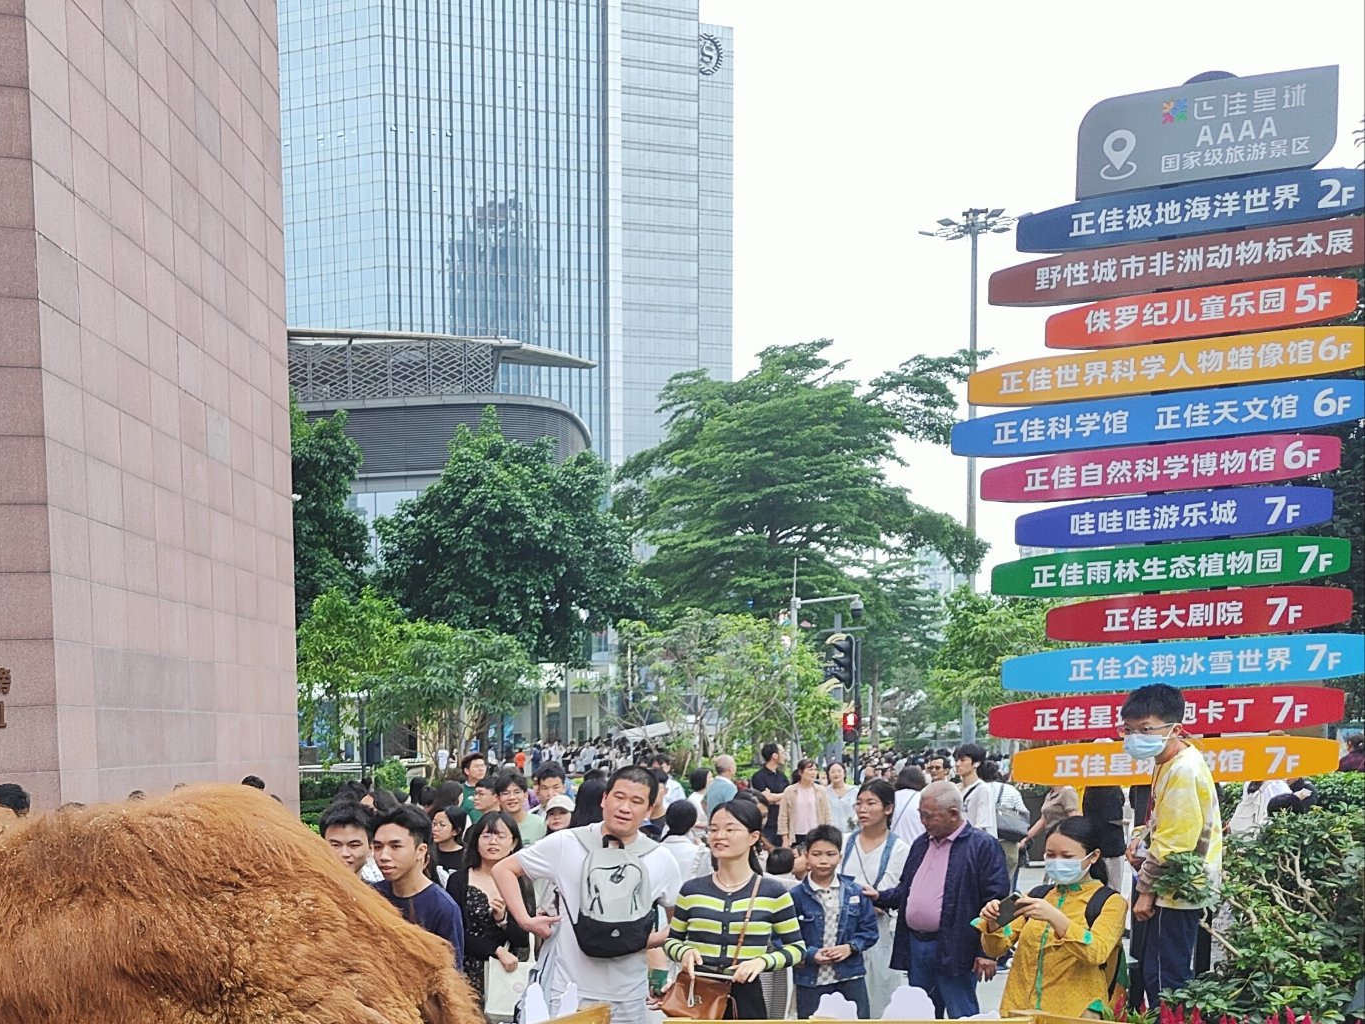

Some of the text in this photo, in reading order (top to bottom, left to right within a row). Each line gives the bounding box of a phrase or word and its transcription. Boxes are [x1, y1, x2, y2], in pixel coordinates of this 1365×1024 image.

[1193, 83, 1307, 120] 正佳星球
[1195, 116, 1278, 147] AAAA
[1161, 136, 1310, 173] 国家级旅游景区
[1069, 178, 1355, 238] 正佳极地海洋世界 2F
[1035, 228, 1354, 291] 野性城市非洲动物标本展
[1085, 283, 1332, 333] 侏罗纪儿童乐园 5F
[999, 335, 1353, 395] 正佳世界科学人物蜡像馆 6F
[992, 387, 1352, 446] 正佳科学馆 正佳天文馆 6F
[1023, 440, 1321, 492] 正佳自然科学博物馆 6F
[1070, 496, 1301, 536] 哇哇哇游乐城 7F
[1031, 545, 1334, 589] 正佳雨林生态植物园 7F
[1103, 597, 1303, 633] 正佳大剧院 7F
[1068, 643, 1342, 682] 正佳企鹅冰雪世界 7F
[1272, 695, 1308, 724] 7F
[1264, 746, 1300, 775] 7F
